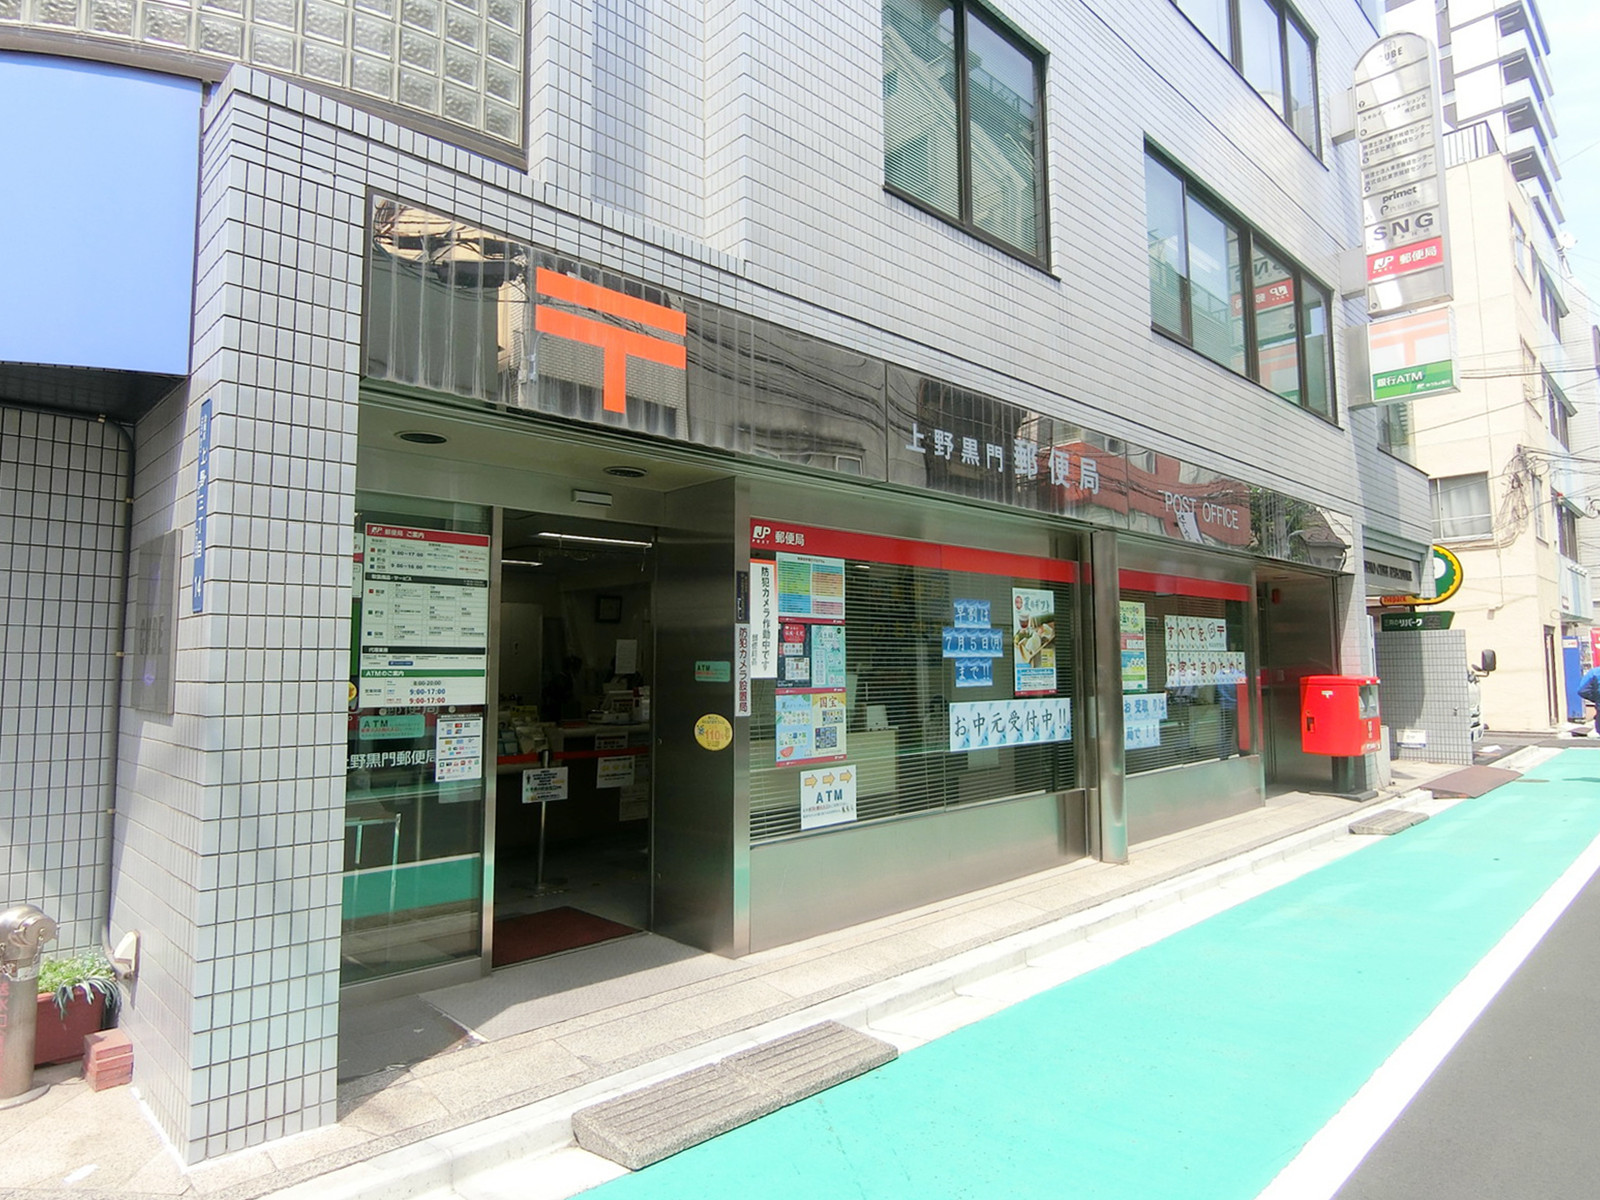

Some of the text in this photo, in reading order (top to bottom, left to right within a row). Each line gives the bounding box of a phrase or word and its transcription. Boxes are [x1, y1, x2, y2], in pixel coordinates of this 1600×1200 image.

[1373, 212, 1434, 241] SNG
[1399, 246, 1437, 265] 郵便局
[905, 422, 1099, 495] 上野黒門郵便局
[1165, 491, 1239, 530] POST OFFICE
[775, 530, 805, 546] 郵便局
[954, 605, 990, 620] 早割は
[945, 634, 1003, 650] 7月5日(月)
[363, 719, 389, 728] ATM
[816, 789, 843, 804] ATM
